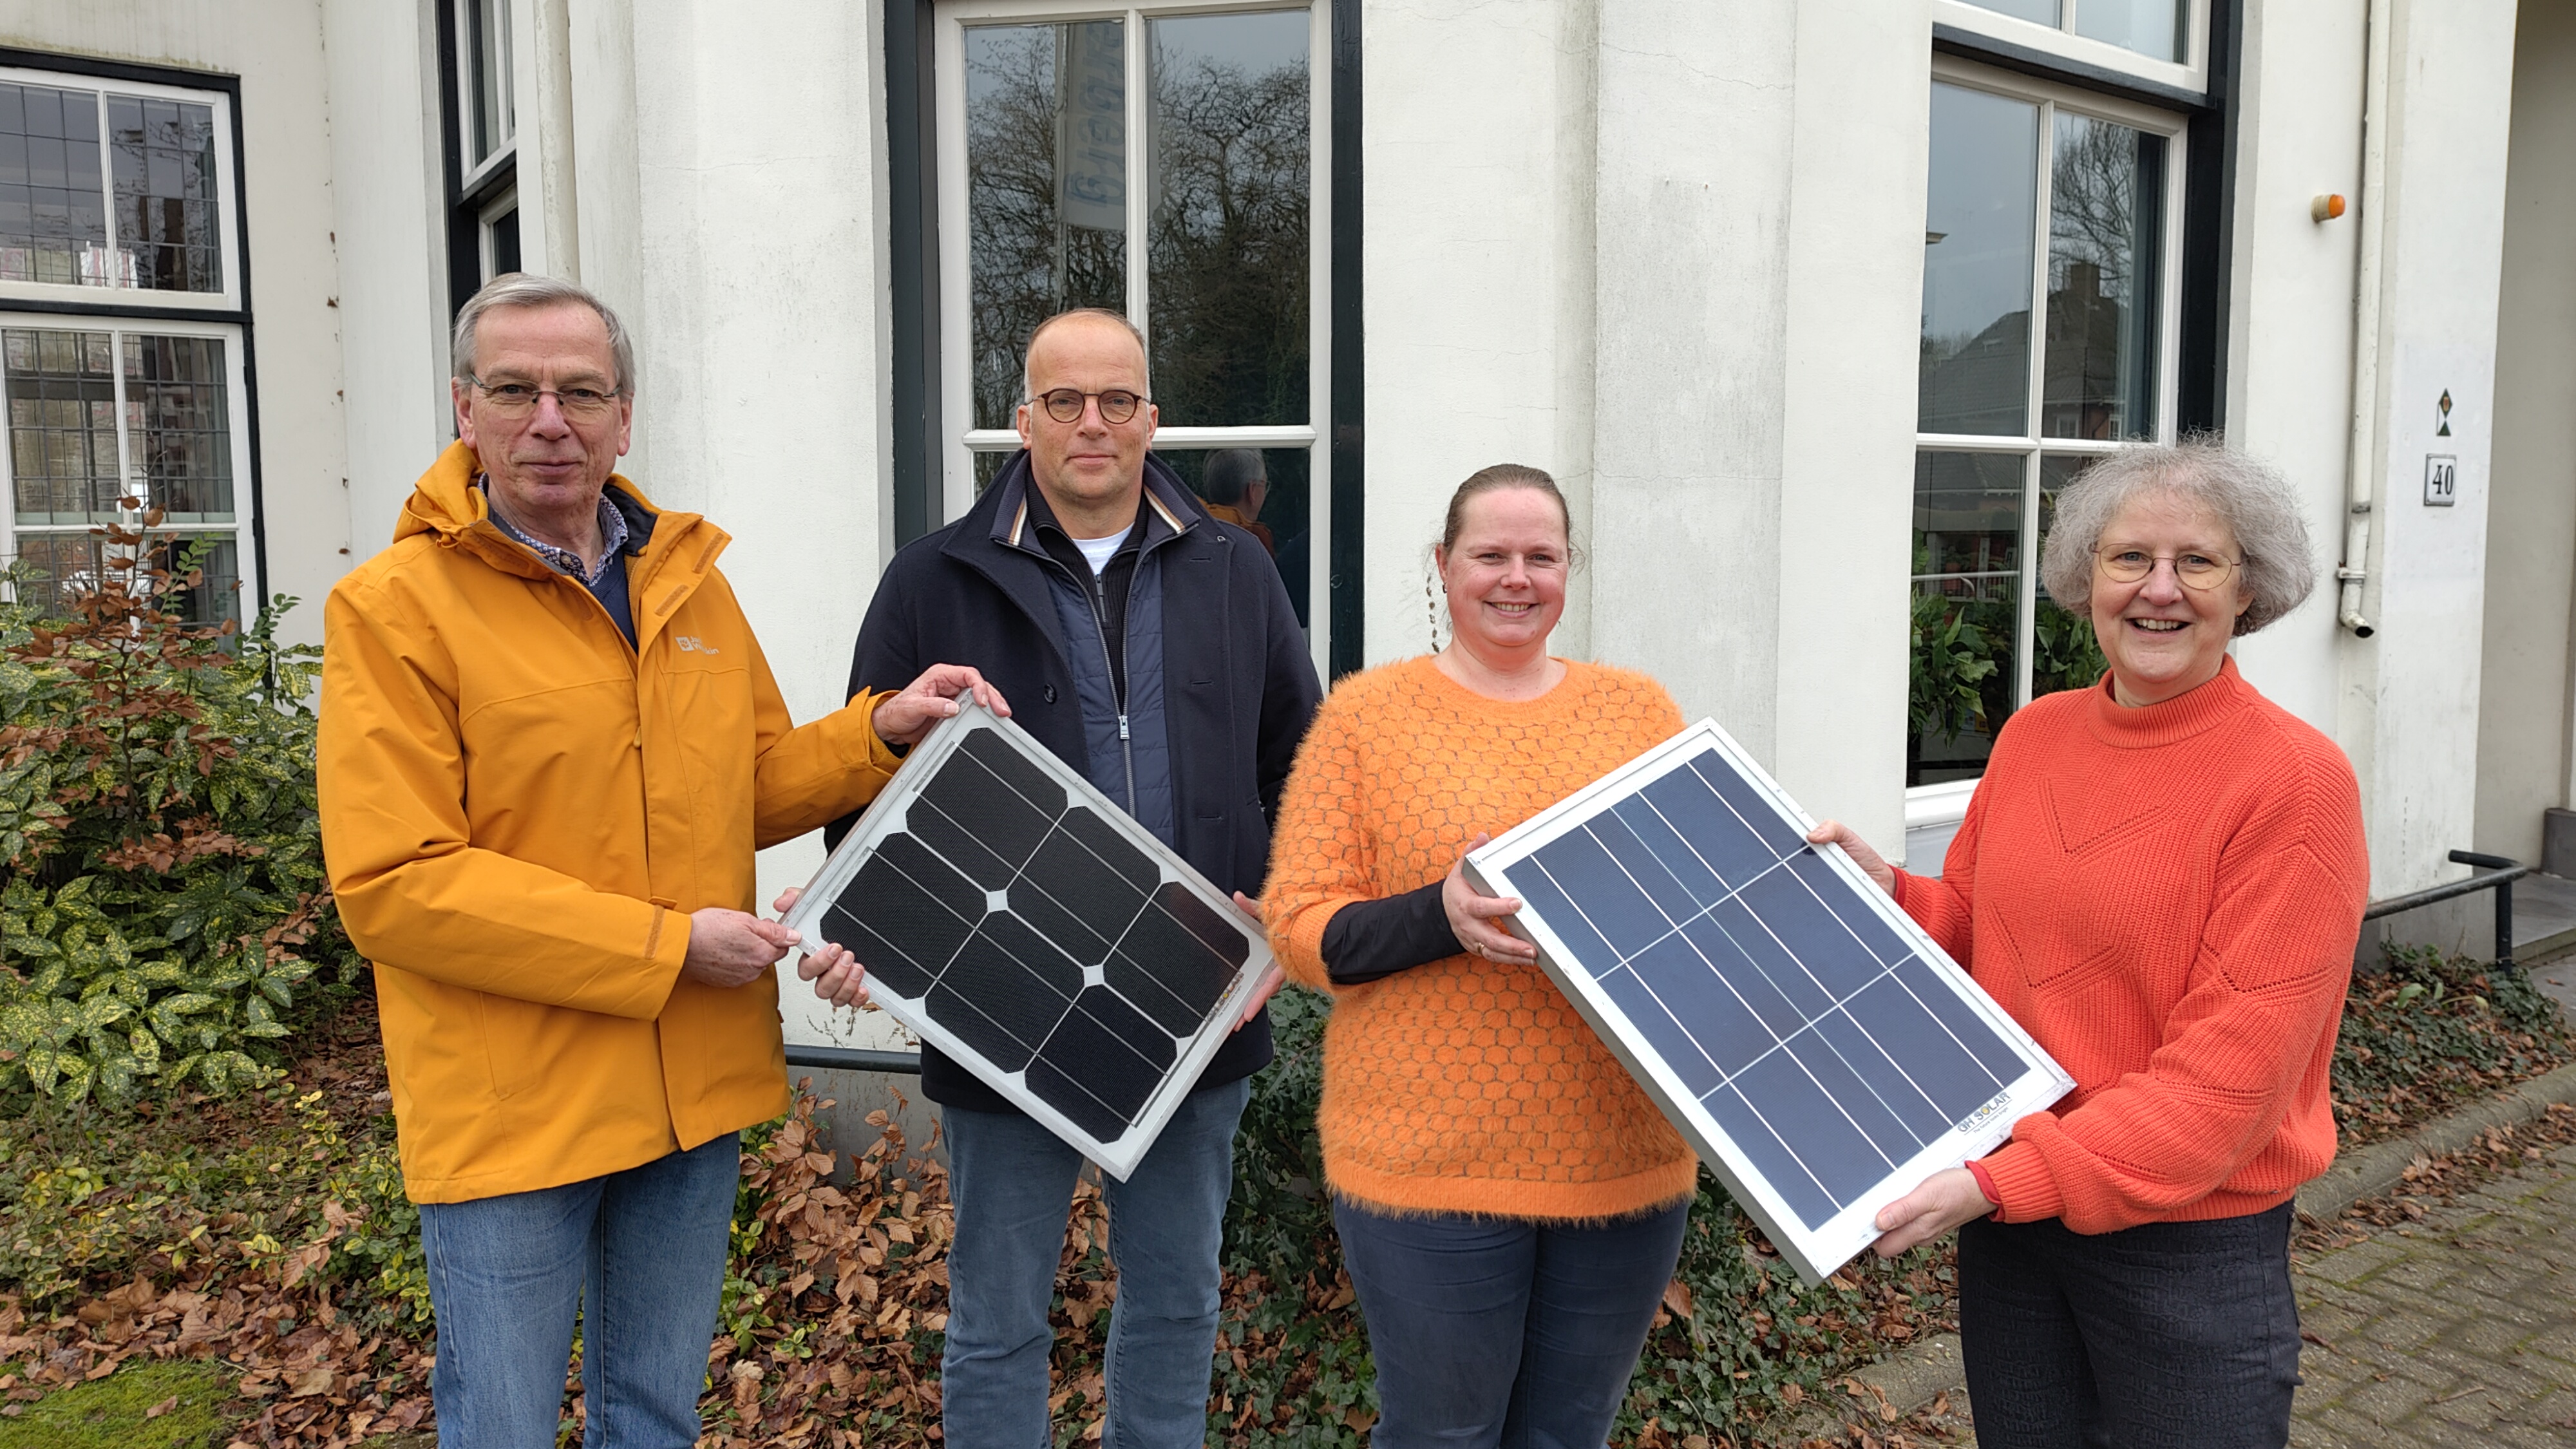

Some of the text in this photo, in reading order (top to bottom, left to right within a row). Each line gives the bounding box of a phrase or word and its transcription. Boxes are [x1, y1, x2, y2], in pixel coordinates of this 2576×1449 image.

[2432, 464, 2454, 495] 40
[1218, 973, 1244, 1005] SOLAR
[1958, 1092, 2011, 1132] GH SOLAR
